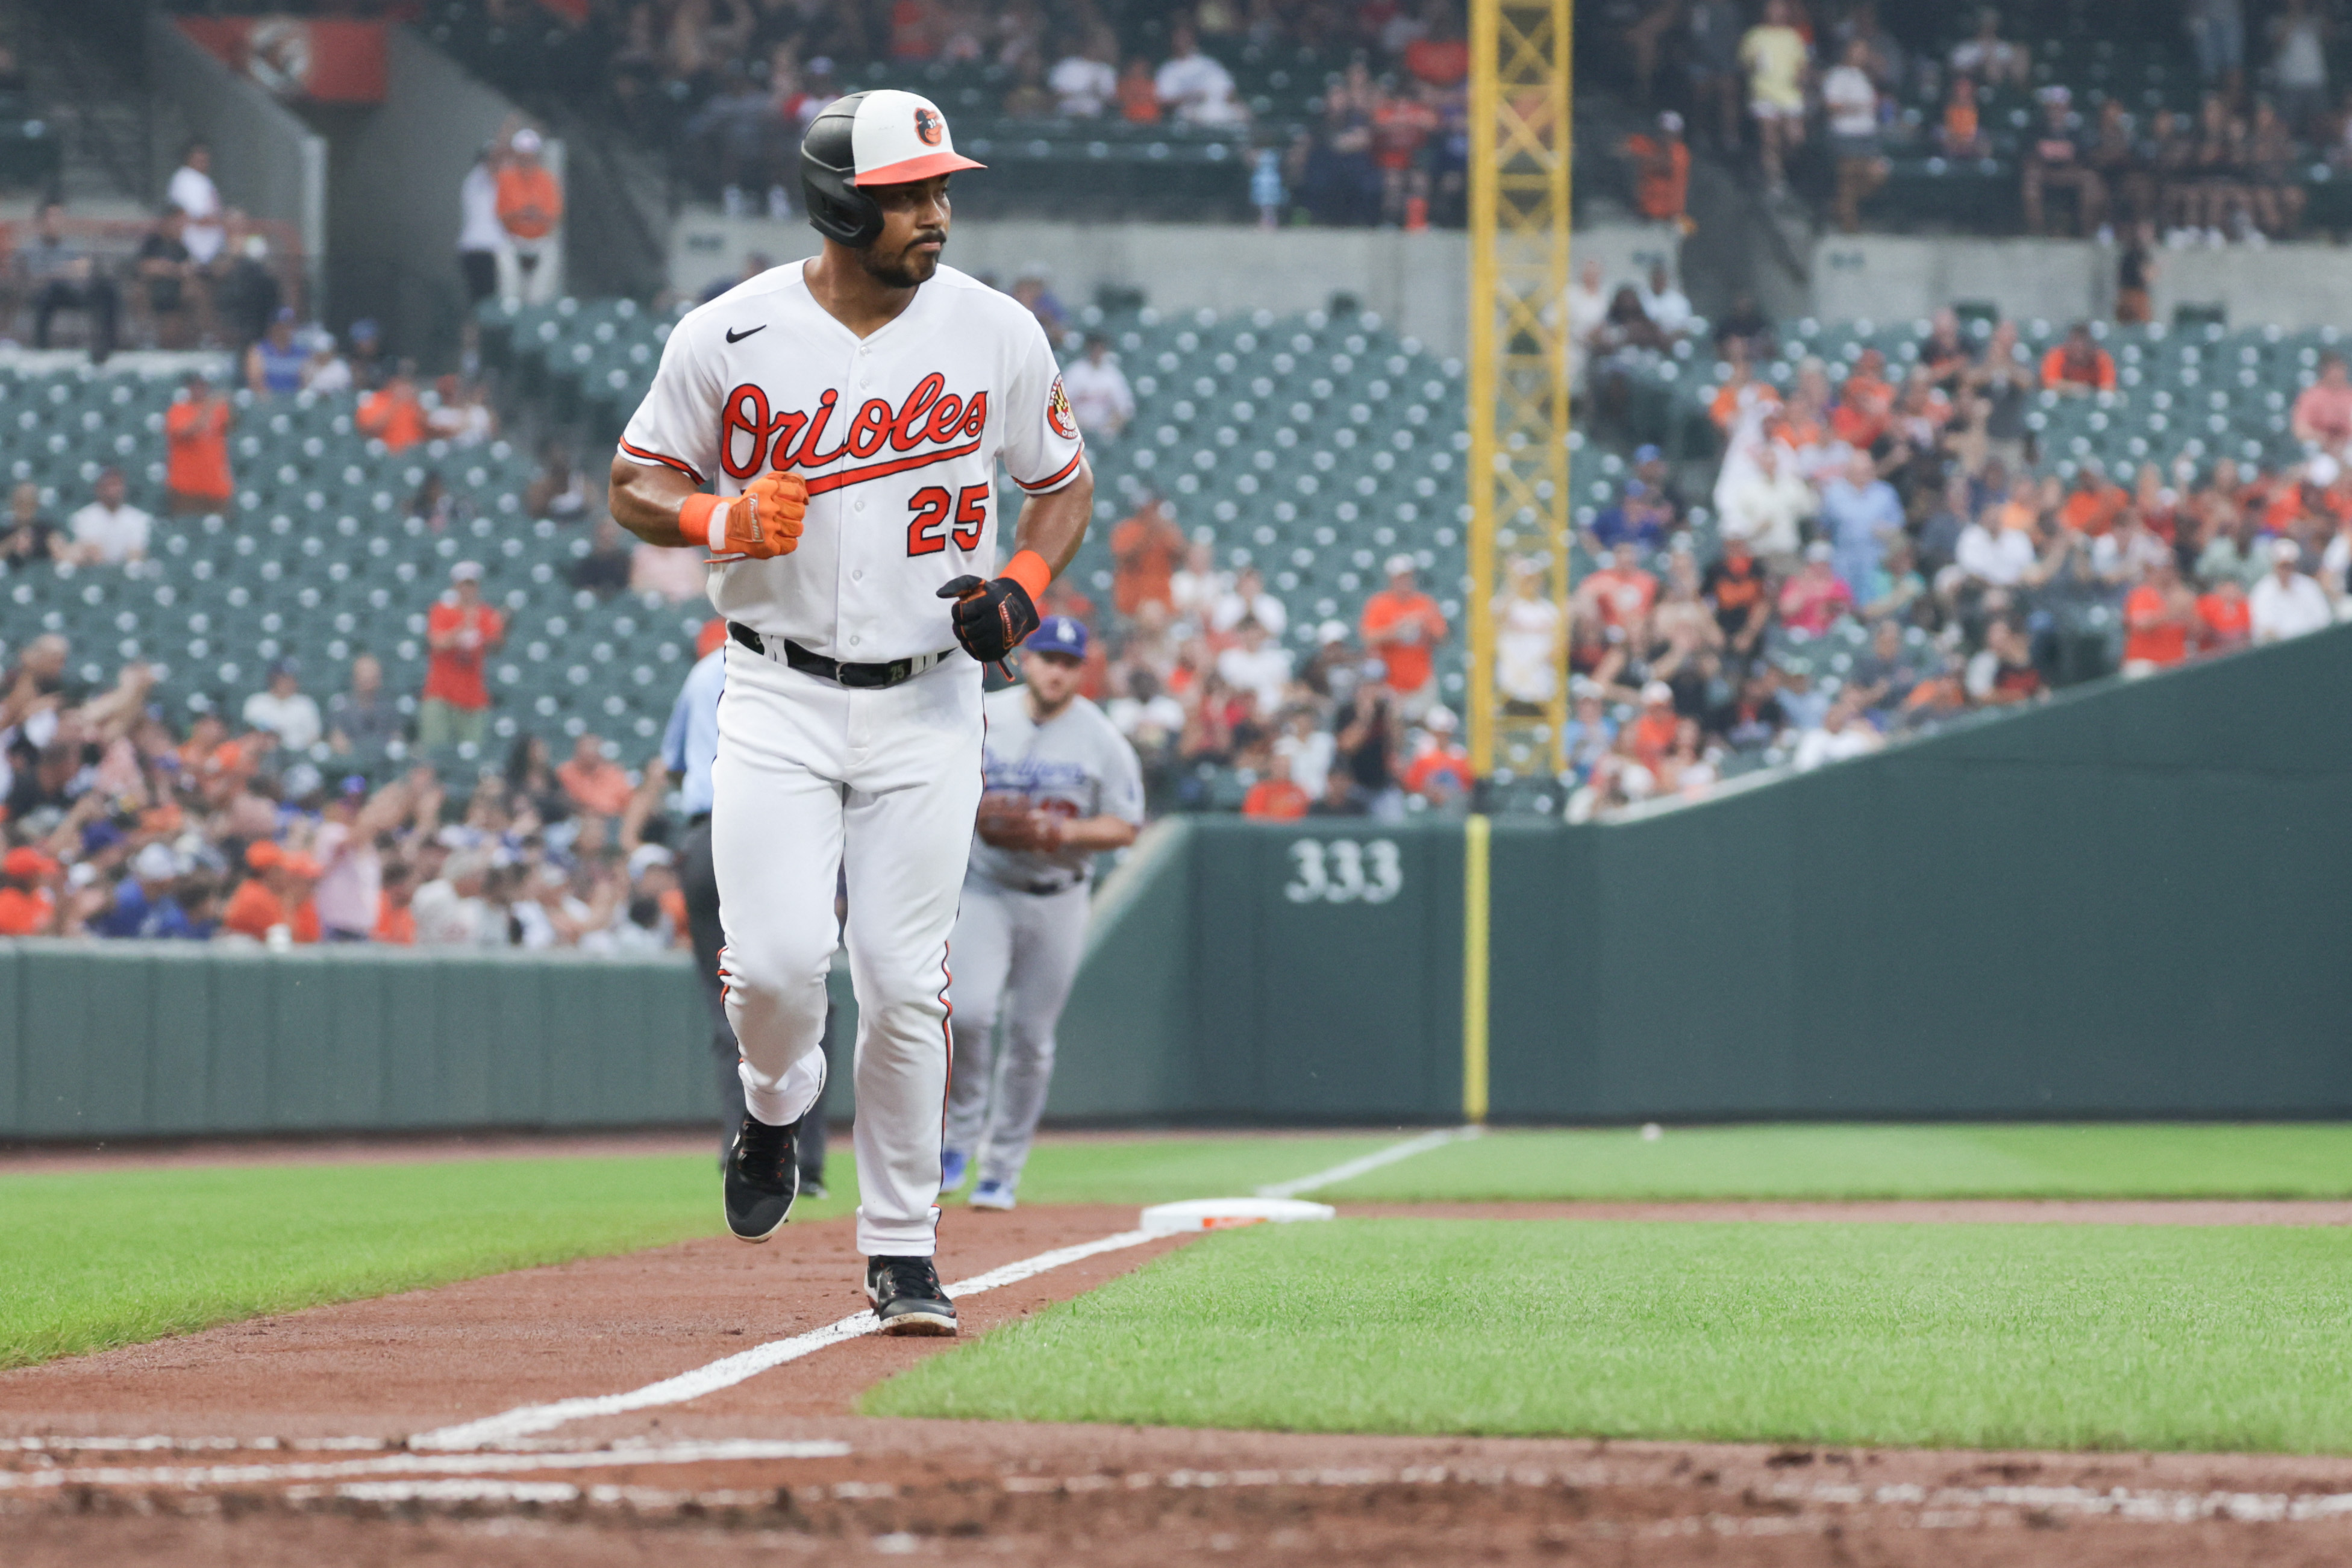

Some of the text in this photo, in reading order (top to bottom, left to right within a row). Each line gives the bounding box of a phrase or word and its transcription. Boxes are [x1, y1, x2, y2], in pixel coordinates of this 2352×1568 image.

[722, 372, 988, 479] Orioles
[907, 481, 989, 557] 25
[1285, 839, 1403, 903] 333
